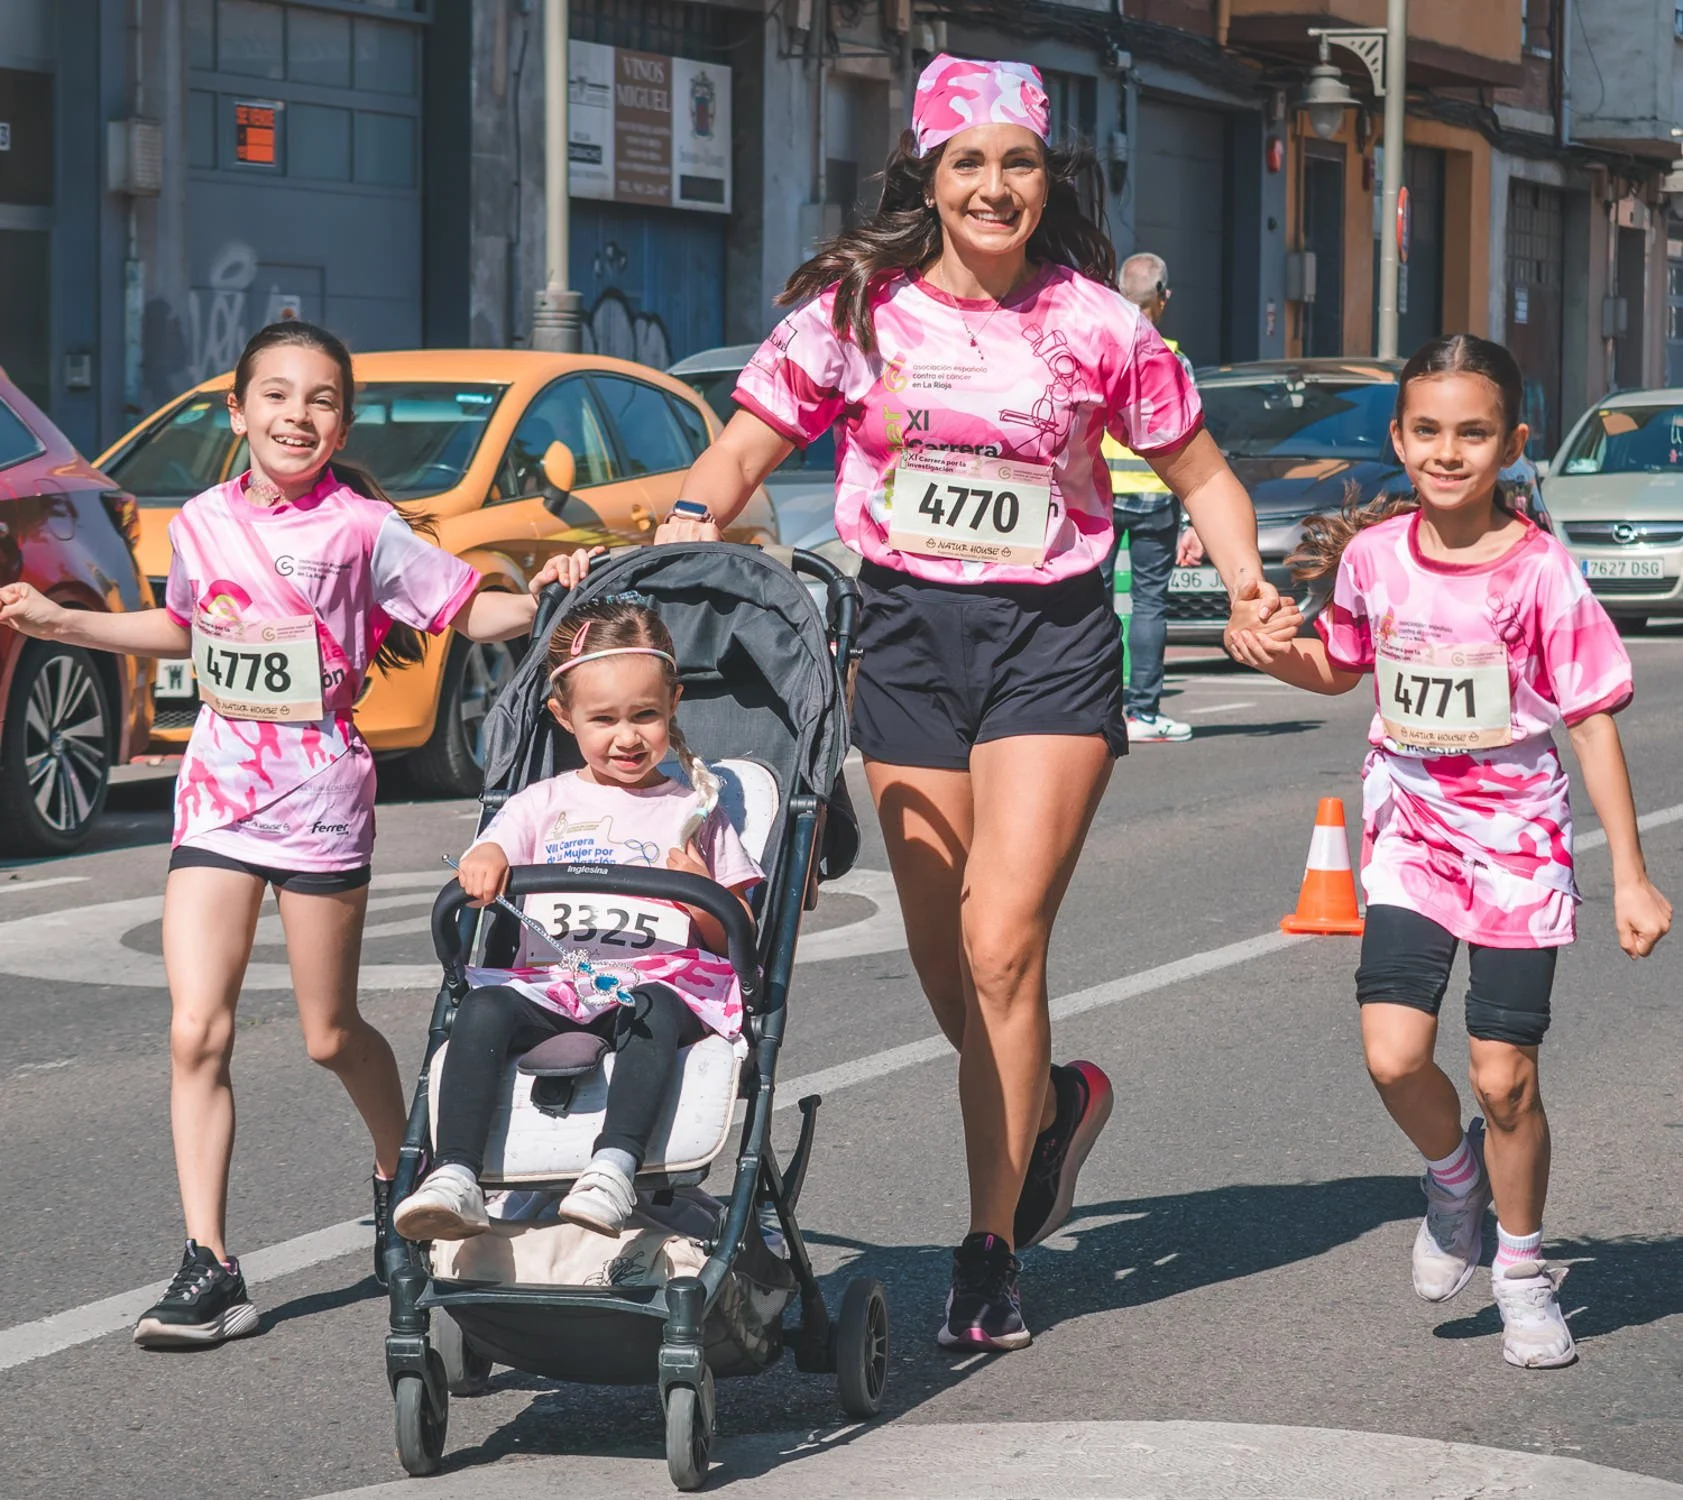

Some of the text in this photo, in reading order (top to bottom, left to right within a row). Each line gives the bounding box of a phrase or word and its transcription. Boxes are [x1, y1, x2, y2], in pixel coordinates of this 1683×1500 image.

[621, 56, 665, 84] VINOS
[934, 381, 952, 390] Rioja
[906, 410, 929, 431] XI
[908, 452, 918, 461] XI
[919, 456, 945, 465] Carrera
[907, 462, 954, 473] investigación
[918, 482, 1019, 533] 4770
[938, 541, 968, 552] NATUR
[970, 545, 1000, 556] HOUSE
[1590, 561, 1659, 576] 7627 DSG
[1170, 572, 1202, 588] 496
[206, 645, 292, 693] 4778
[1395, 672, 1476, 718] 4771
[564, 847, 593, 860] Mujer
[595, 848, 614, 858] por
[551, 903, 659, 949] 3325
